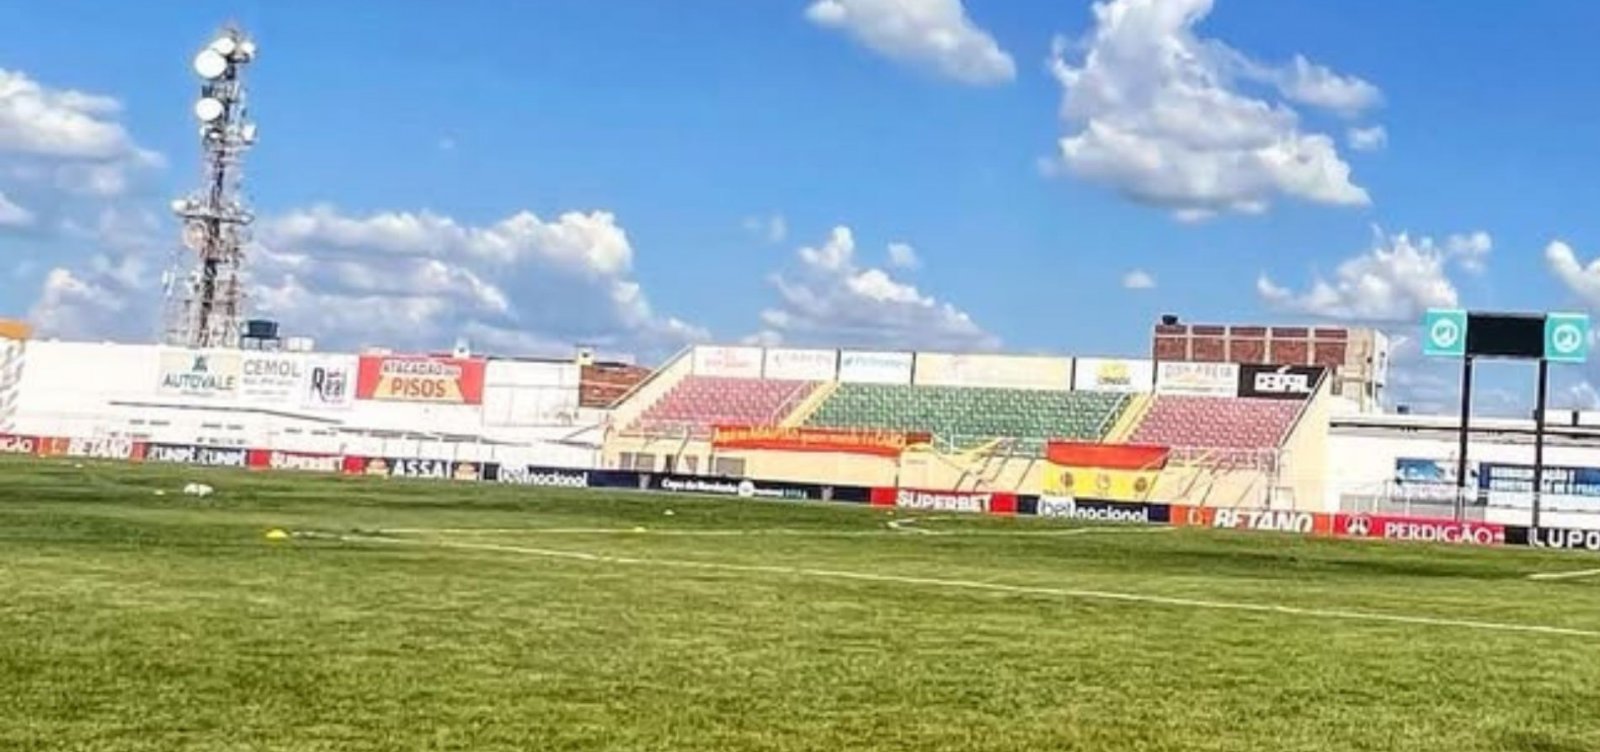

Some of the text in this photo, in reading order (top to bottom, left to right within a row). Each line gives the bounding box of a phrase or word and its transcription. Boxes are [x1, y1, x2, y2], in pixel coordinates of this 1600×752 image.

[243, 359, 301, 378] CEMOL
[162, 373, 235, 391] AUTOVALE
[391, 376, 446, 398] PISOS
[898, 490, 990, 511] SUPERBET
[1214, 508, 1312, 532] BETANO
[1384, 520, 1492, 545] PERDIGÃO
[1534, 528, 1600, 550] LUPO
